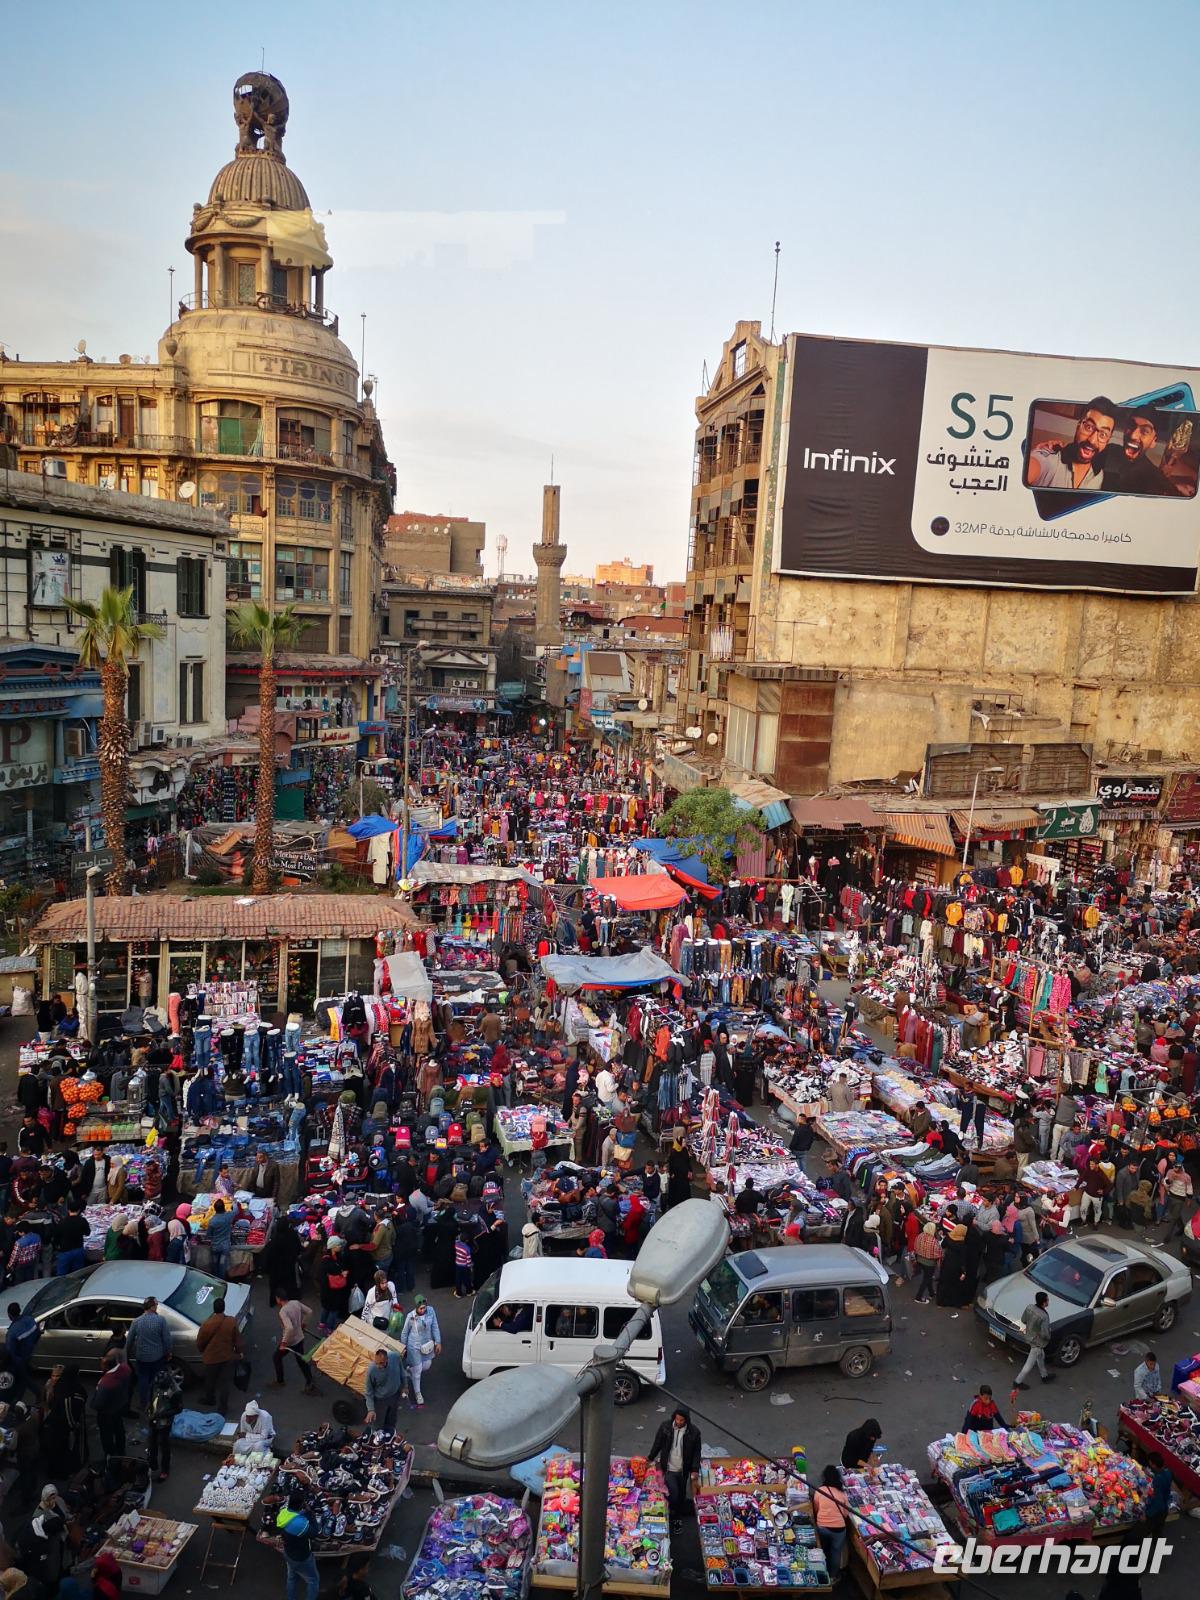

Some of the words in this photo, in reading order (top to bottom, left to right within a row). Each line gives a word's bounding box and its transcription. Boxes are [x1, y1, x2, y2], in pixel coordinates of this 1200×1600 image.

[260, 355, 345, 387] TIRING
[945, 391, 1014, 442] S5
[803, 447, 897, 476] Infinix
[926, 445, 1010, 472] هتشوف
[949, 474, 1008, 497] العجب
[954, 521, 988, 535] 32MP
[1016, 524, 1060, 543] بالشاشة
[1061, 527, 1099, 544] مدمجة
[1100, 525, 1132, 544] كاميرا
